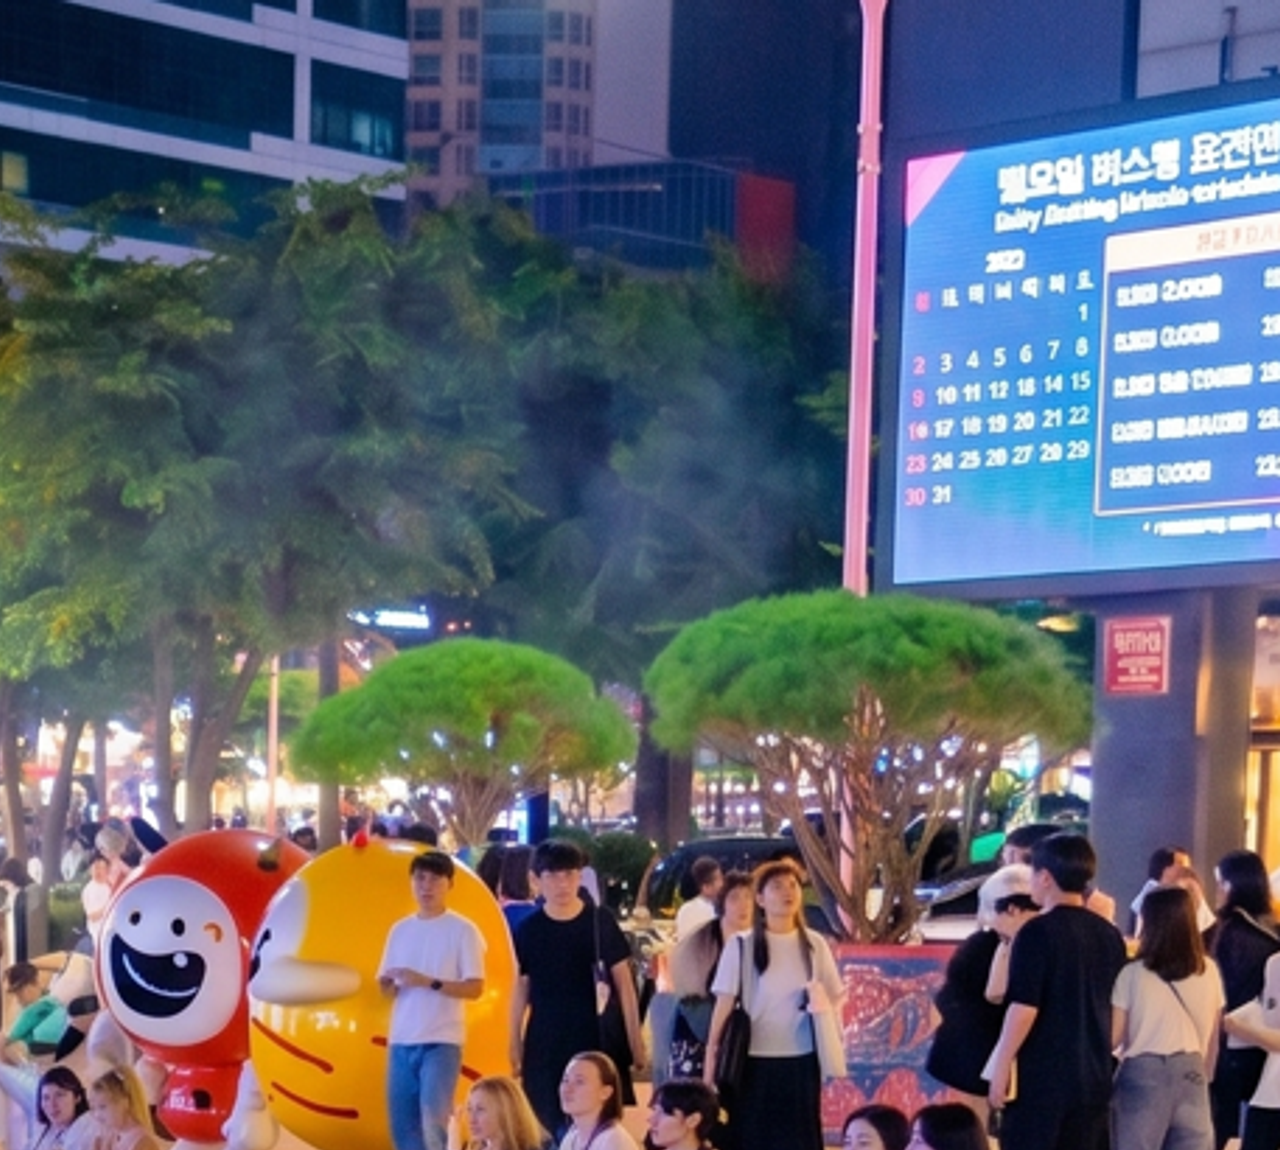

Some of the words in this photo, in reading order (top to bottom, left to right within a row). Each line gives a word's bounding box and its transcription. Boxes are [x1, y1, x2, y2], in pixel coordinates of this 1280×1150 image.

[1078, 303, 1088, 322] 1
[912, 356, 926, 376] 2
[940, 353, 954, 374] 3
[966, 350, 981, 369] 4
[992, 347, 1007, 368] 5
[1019, 344, 1033, 364] 6
[1046, 340, 1061, 361] 7
[1074, 336, 1089, 357] 8
[911, 388, 926, 408] 9
[936, 385, 958, 406] 10
[962, 382, 982, 402] 11
[988, 380, 1010, 400] 12
[1045, 374, 1064, 394] 14
[1071, 370, 1091, 391] 15
[933, 418, 954, 438] 17
[961, 415, 982, 436] 18
[987, 413, 1008, 434] 19
[1013, 410, 1036, 432] 20
[1042, 408, 1063, 429] 21
[1068, 405, 1090, 426] 22
[931, 451, 954, 472] 24
[1011, 444, 1034, 466] 27
[1066, 439, 1090, 460] 29
[931, 484, 952, 505] 31
